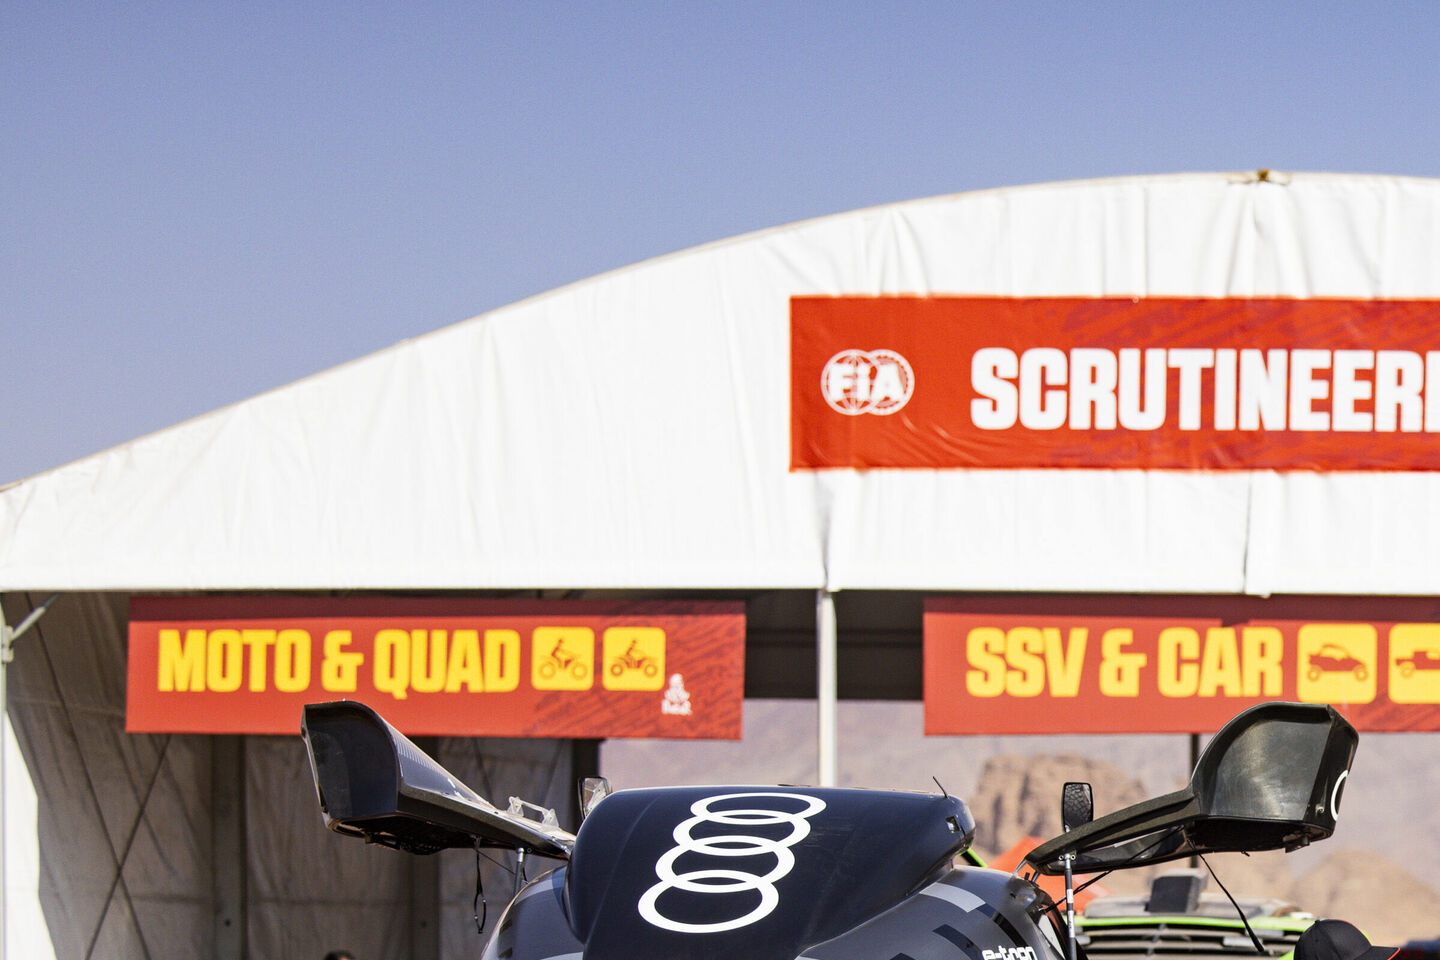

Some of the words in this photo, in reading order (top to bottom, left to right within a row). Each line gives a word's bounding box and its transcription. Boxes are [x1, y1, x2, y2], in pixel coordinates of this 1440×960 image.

[158, 629, 311, 692] MOTO
[321, 630, 364, 692] &
[373, 629, 520, 699] QUAD
[966, 627, 1088, 697] SSV
[1099, 628, 1147, 697] &
[1158, 627, 1283, 697] CAR
